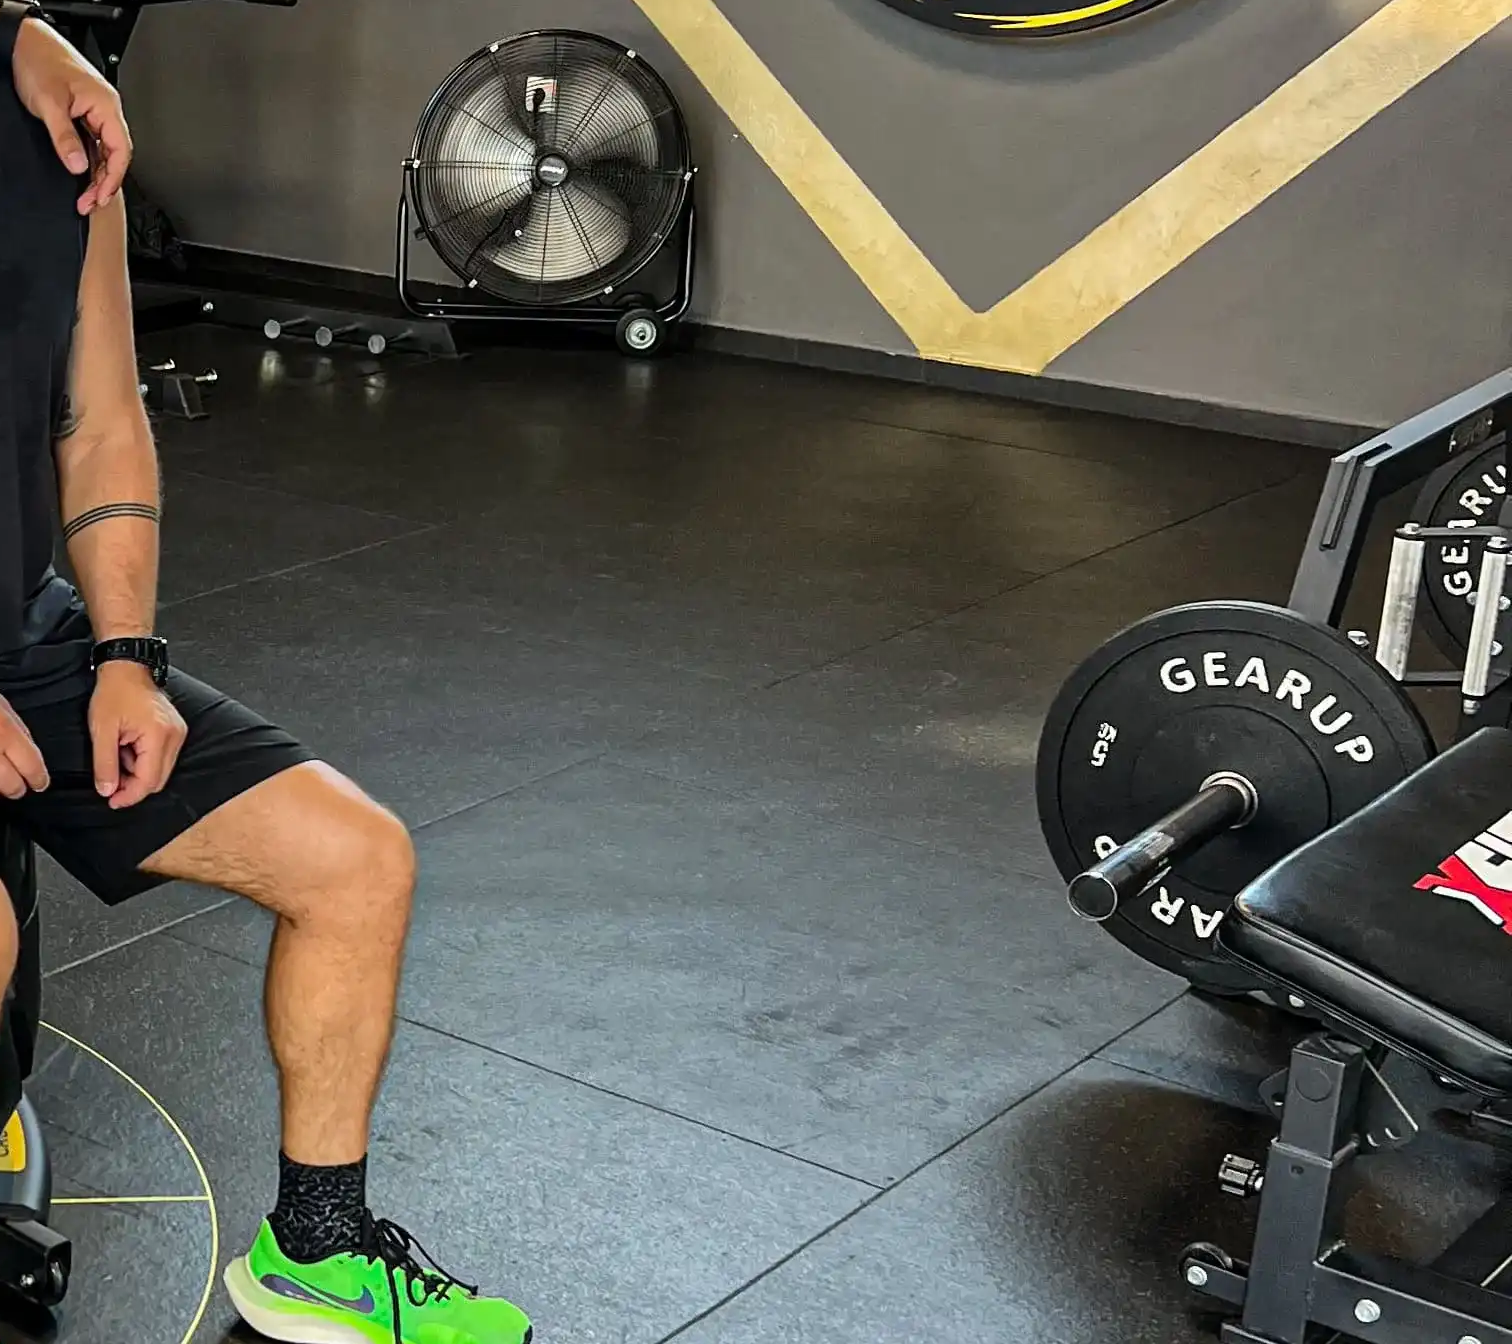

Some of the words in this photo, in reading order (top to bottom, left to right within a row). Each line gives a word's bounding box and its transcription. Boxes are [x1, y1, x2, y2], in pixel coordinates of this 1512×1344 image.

[1441, 464, 1506, 596] GERU
[1090, 739, 1109, 767] 5
[1159, 651, 1374, 763] GEARUP
